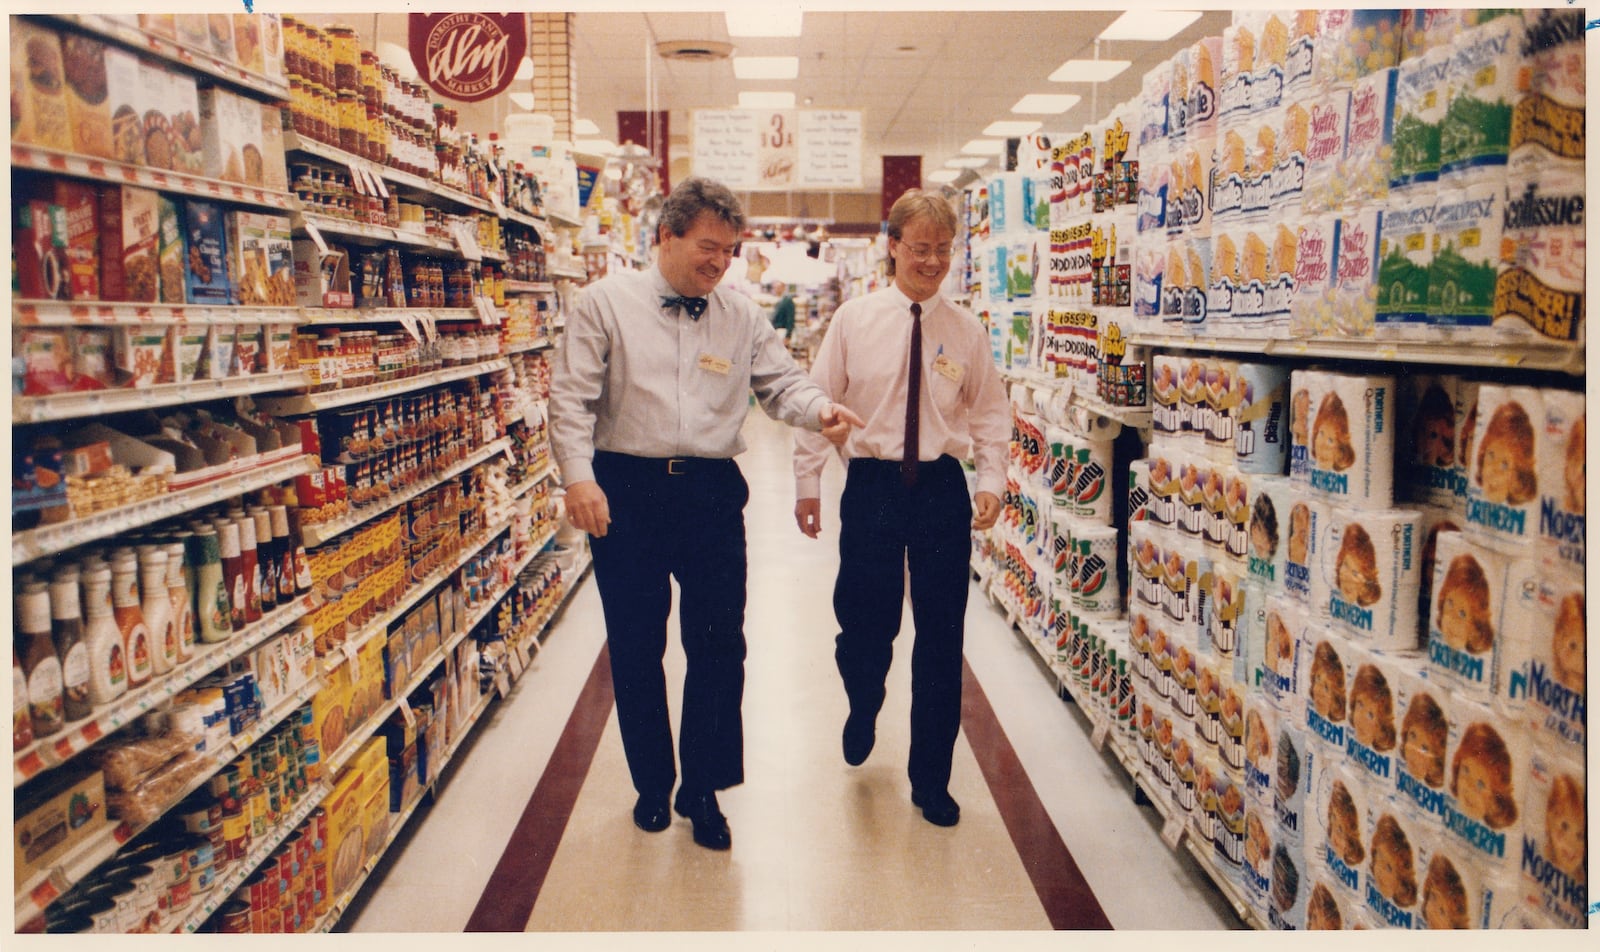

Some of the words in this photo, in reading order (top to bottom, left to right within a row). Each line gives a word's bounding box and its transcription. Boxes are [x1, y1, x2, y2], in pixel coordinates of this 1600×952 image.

[430, 14, 469, 49] DOROTHY
[473, 14, 500, 39] LANE
[447, 78, 493, 93] MARKET
[771, 113, 785, 149] 3
[1264, 401, 1282, 444] Charmin
[1402, 522, 1414, 571] NORTHERN
[1330, 595, 1373, 631] ORTHERN
[1429, 639, 1485, 683] ORTHERN
[1443, 803, 1507, 859] ORTHERN
